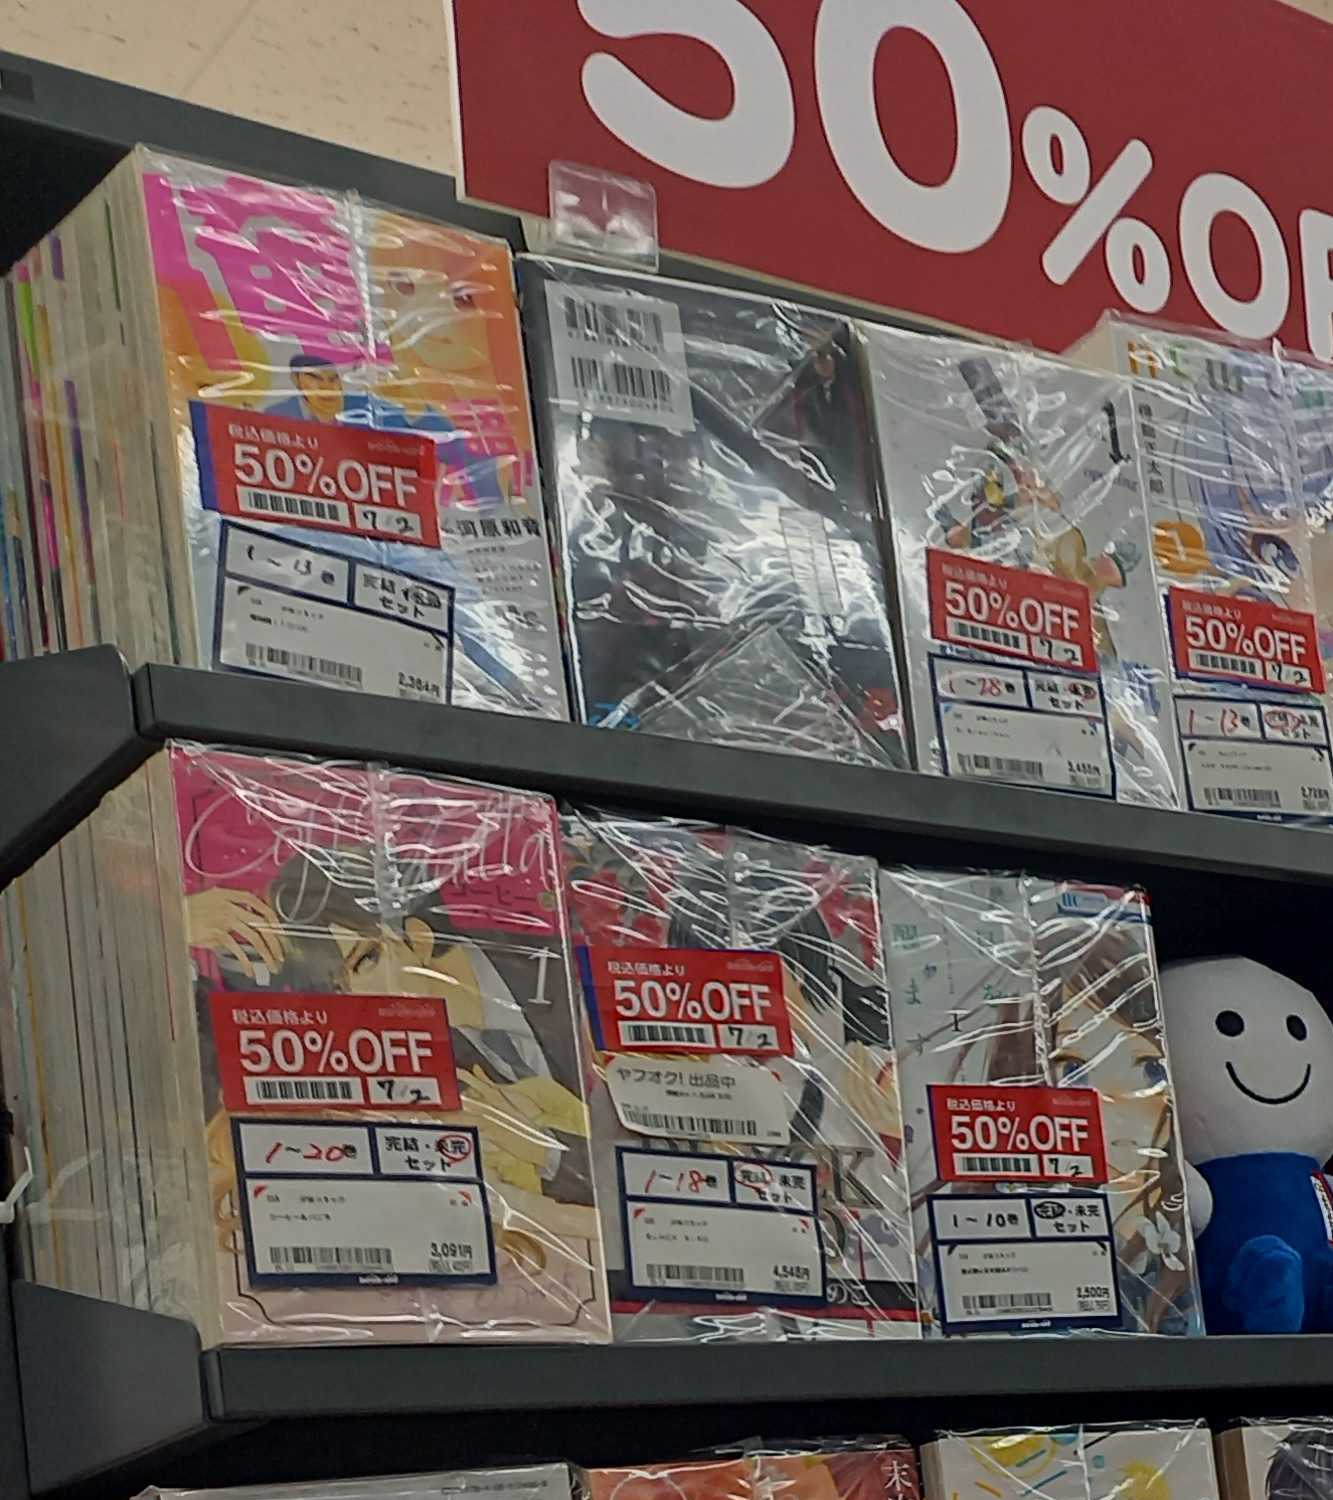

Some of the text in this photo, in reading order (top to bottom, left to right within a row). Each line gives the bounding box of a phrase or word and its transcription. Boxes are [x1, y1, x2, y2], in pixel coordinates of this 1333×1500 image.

[234, 443, 418, 508] 50%OFF
[945, 583, 1081, 642] 50%OFF
[1185, 616, 1307, 662] 50%OFF
[607, 960, 686, 976] 税込価格より
[232, 1008, 329, 1026] 税込価格より
[615, 979, 773, 1023] 50%OFF
[239, 1029, 433, 1075] 50%OFF
[951, 1115, 1090, 1152] 50%OFF
[404, 1156, 452, 1172] セット
[1053, 1219, 1091, 1234] セット
